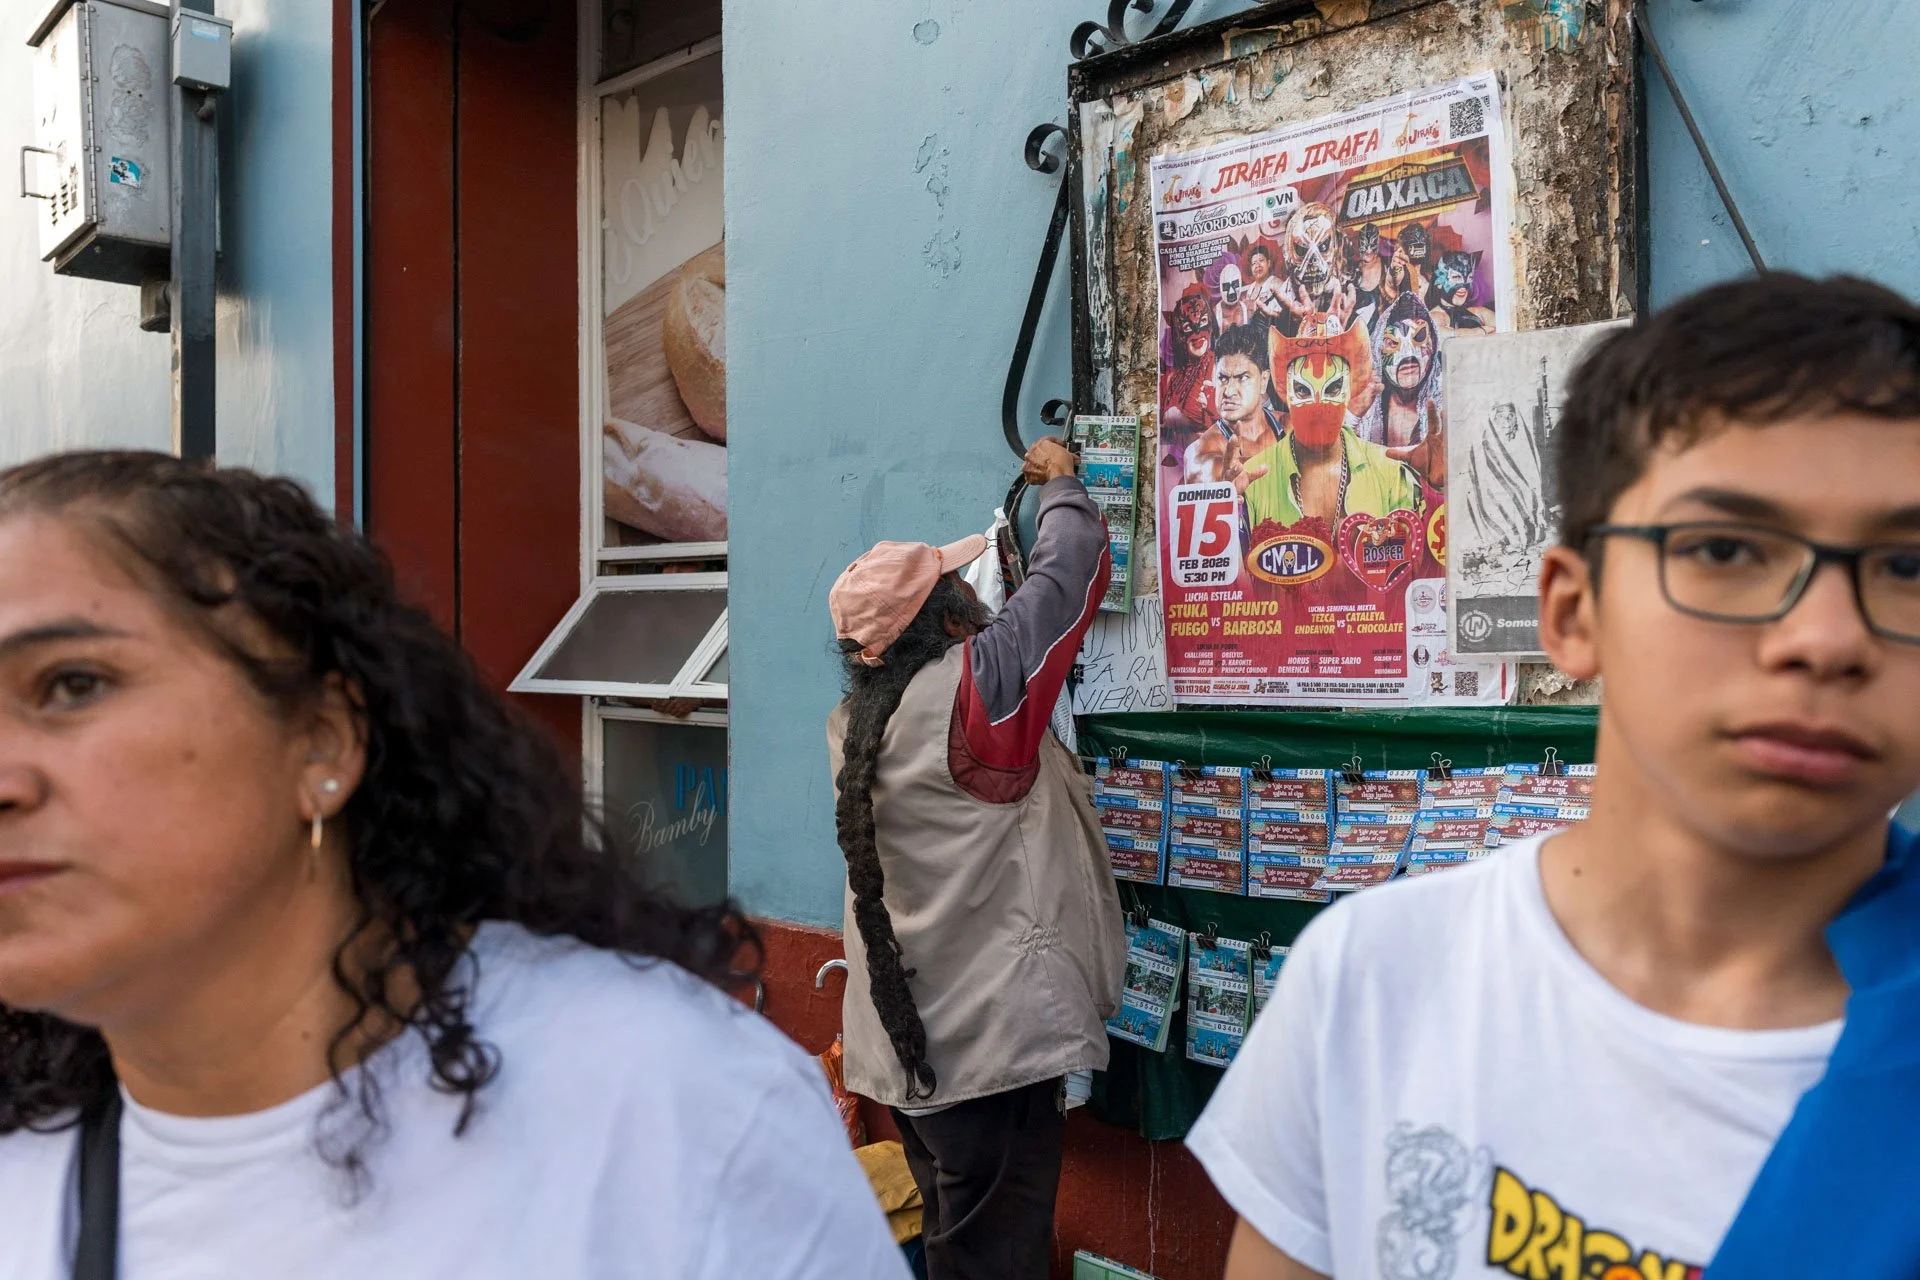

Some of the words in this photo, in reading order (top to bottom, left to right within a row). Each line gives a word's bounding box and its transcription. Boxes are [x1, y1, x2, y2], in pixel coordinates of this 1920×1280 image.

[1210, 151, 1288, 194] JIRAFA
[1296, 128, 1380, 174] JIRAFA
[1381, 165, 1428, 181] ARENA
[1346, 164, 1470, 219] OAXACA
[1180, 212, 1258, 239] MAYORDOMO
[1109, 456, 1134, 464] 28720
[1178, 488, 1231, 502] DOMINGO
[1176, 502, 1234, 558] 15
[1179, 560, 1199, 570] FEB
[1202, 558, 1230, 568] 2026
[1262, 544, 1318, 577] CMLL
[1212, 571, 1226, 582] PM
[1184, 592, 1209, 602] LUCHA
[1210, 591, 1243, 601] ESTELAR
[1169, 604, 1208, 618] STUKA
[1222, 601, 1278, 616] DIFUNTO
[1312, 614, 1335, 622] TEZCA
[1346, 612, 1385, 622] CATALEYA
[1170, 622, 1209, 636] FUEGO
[1222, 620, 1282, 635] BARBOSA
[1294, 624, 1335, 634] ENDEAVOR
[1357, 622, 1404, 634] CHOCOLATE
[1497, 619, 1538, 628] Somos
[1288, 657, 1310, 665] HORUS
[1319, 657, 1340, 665] SUPER
[1278, 666, 1310, 674] DEMENCIA
[1319, 666, 1342, 674] TAMUZ
[1174, 685, 1185, 694] 951
[1078, 685, 1168, 712] VIERNES
[1140, 760, 1162, 769] 02982
[1300, 768, 1324, 776] 45065
[1535, 778, 1552, 786] Vale
[1552, 778, 1568, 788] por
[1548, 787, 1568, 795] cena
[1139, 800, 1162, 810] 02982
[1300, 812, 1326, 821] 45065
[1523, 820, 1540, 829] Vale
[1135, 841, 1159, 850] 02982
[1302, 857, 1326, 865] 45065
[1152, 962, 1176, 974] 55407
[1222, 981, 1248, 991] 03468
[1139, 1002, 1164, 1014] 55407
[1217, 1024, 1242, 1034] 03468
